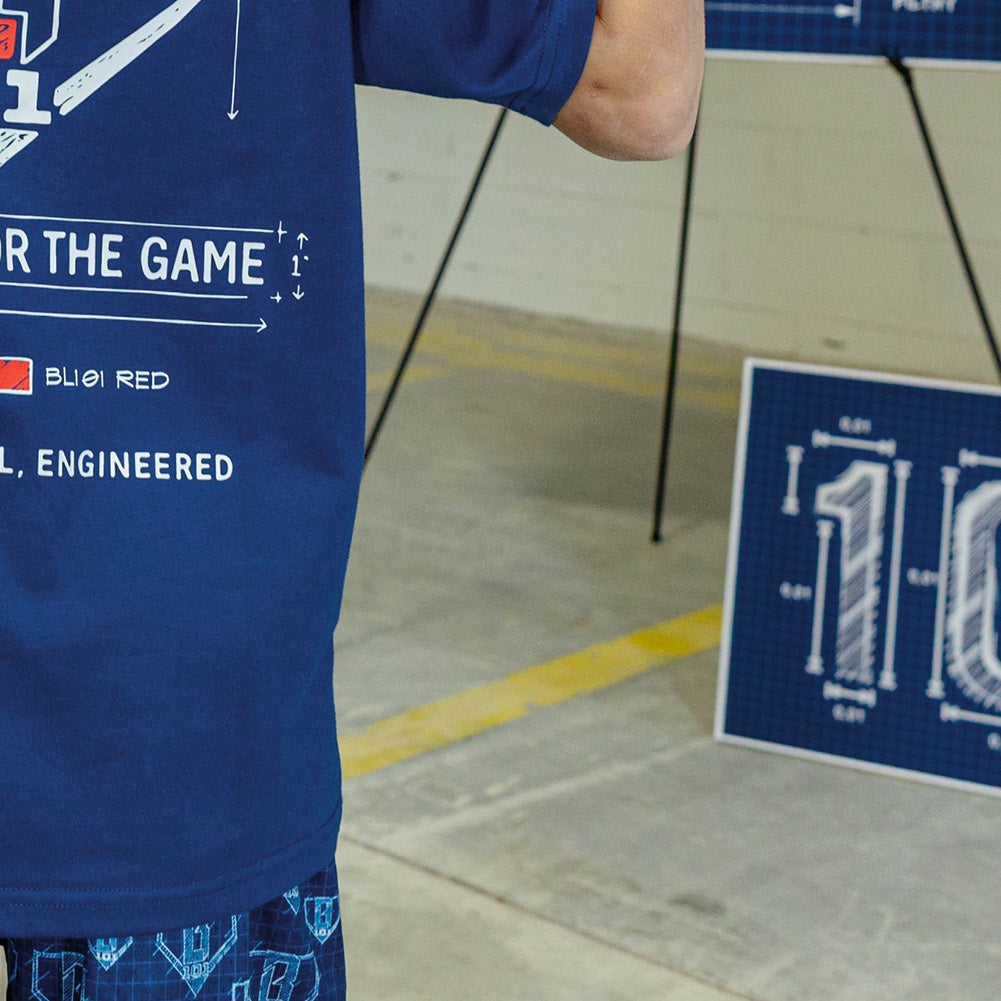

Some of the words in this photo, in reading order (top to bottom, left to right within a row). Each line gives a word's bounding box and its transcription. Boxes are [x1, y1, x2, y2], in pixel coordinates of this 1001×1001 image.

[42, 230, 124, 278] THE
[140, 236, 266, 285] GAME
[115, 369, 170, 390] RED
[37, 448, 234, 482] ENGINEERED
